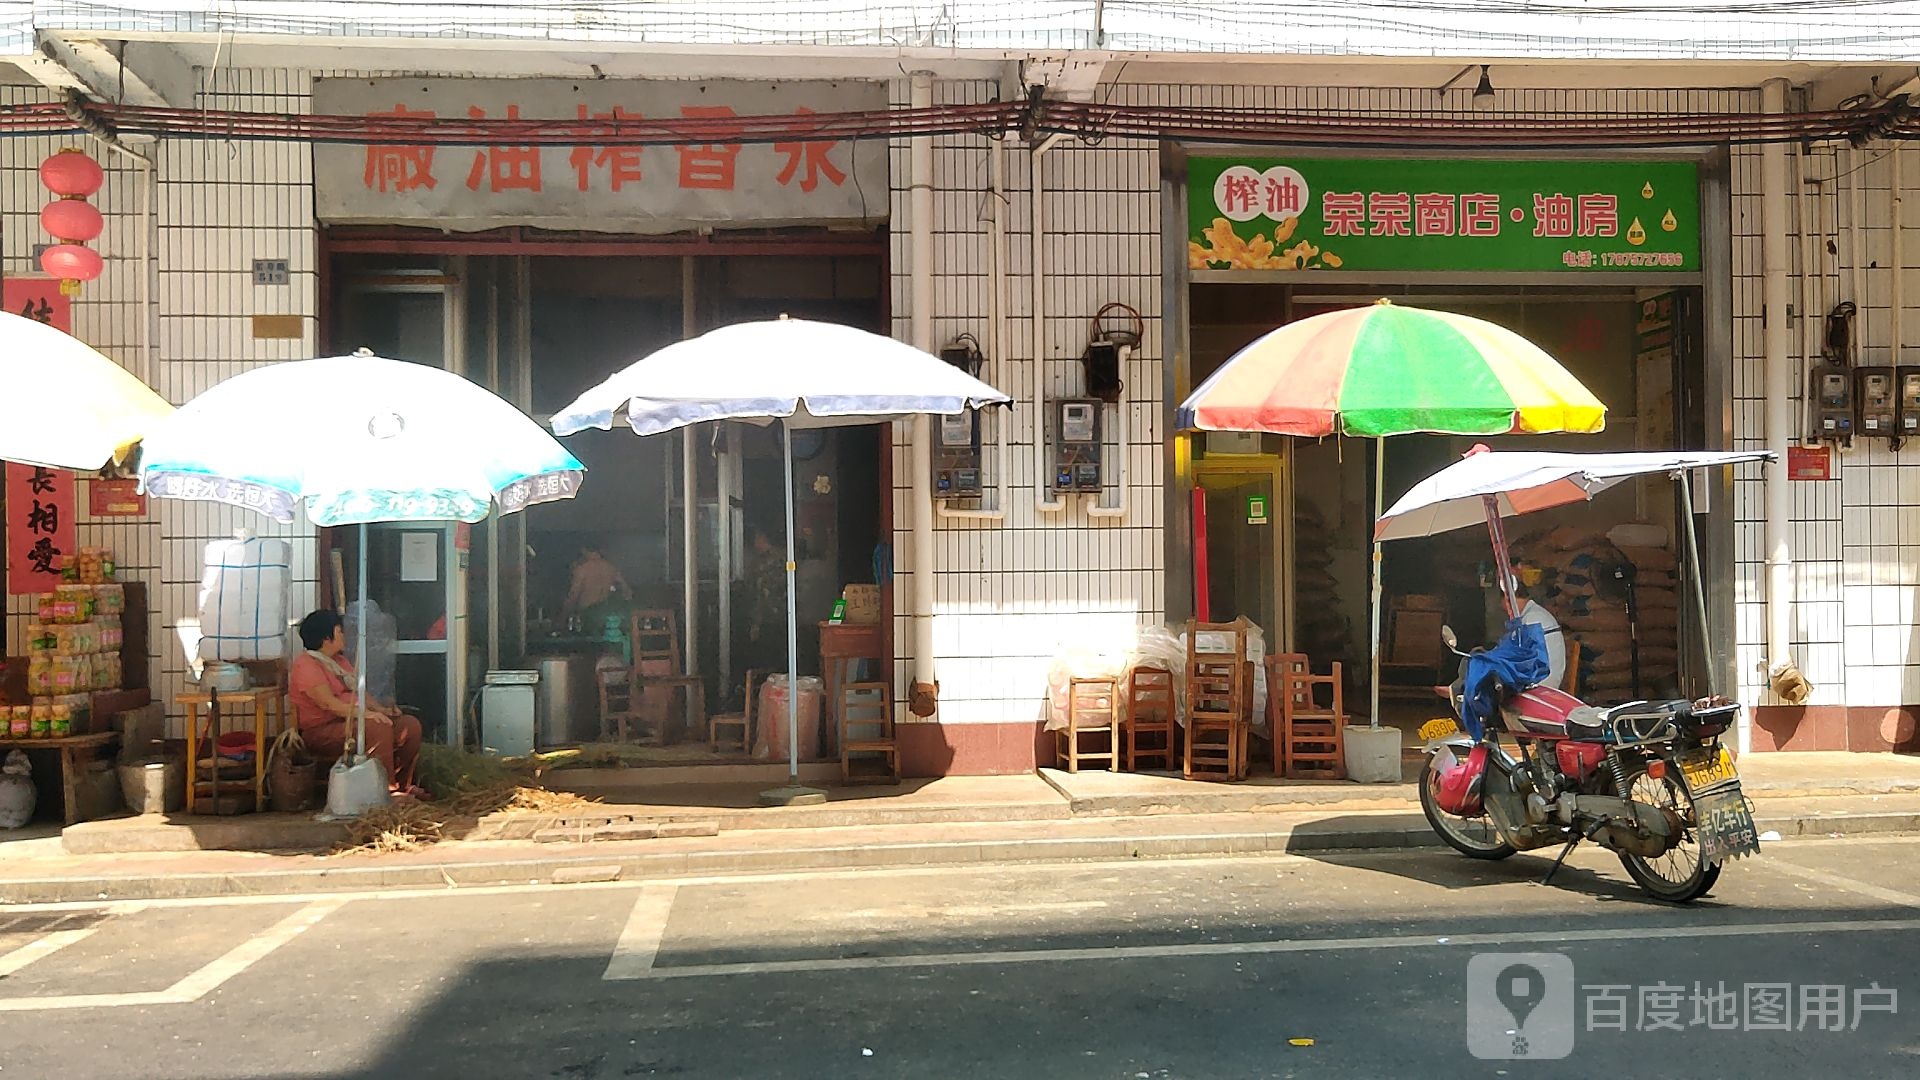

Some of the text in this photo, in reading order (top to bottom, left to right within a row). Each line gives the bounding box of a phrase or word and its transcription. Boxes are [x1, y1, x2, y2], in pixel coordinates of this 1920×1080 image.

[1223, 175, 1300, 213] 榨油
[1704, 829, 1754, 857] 出入平安
